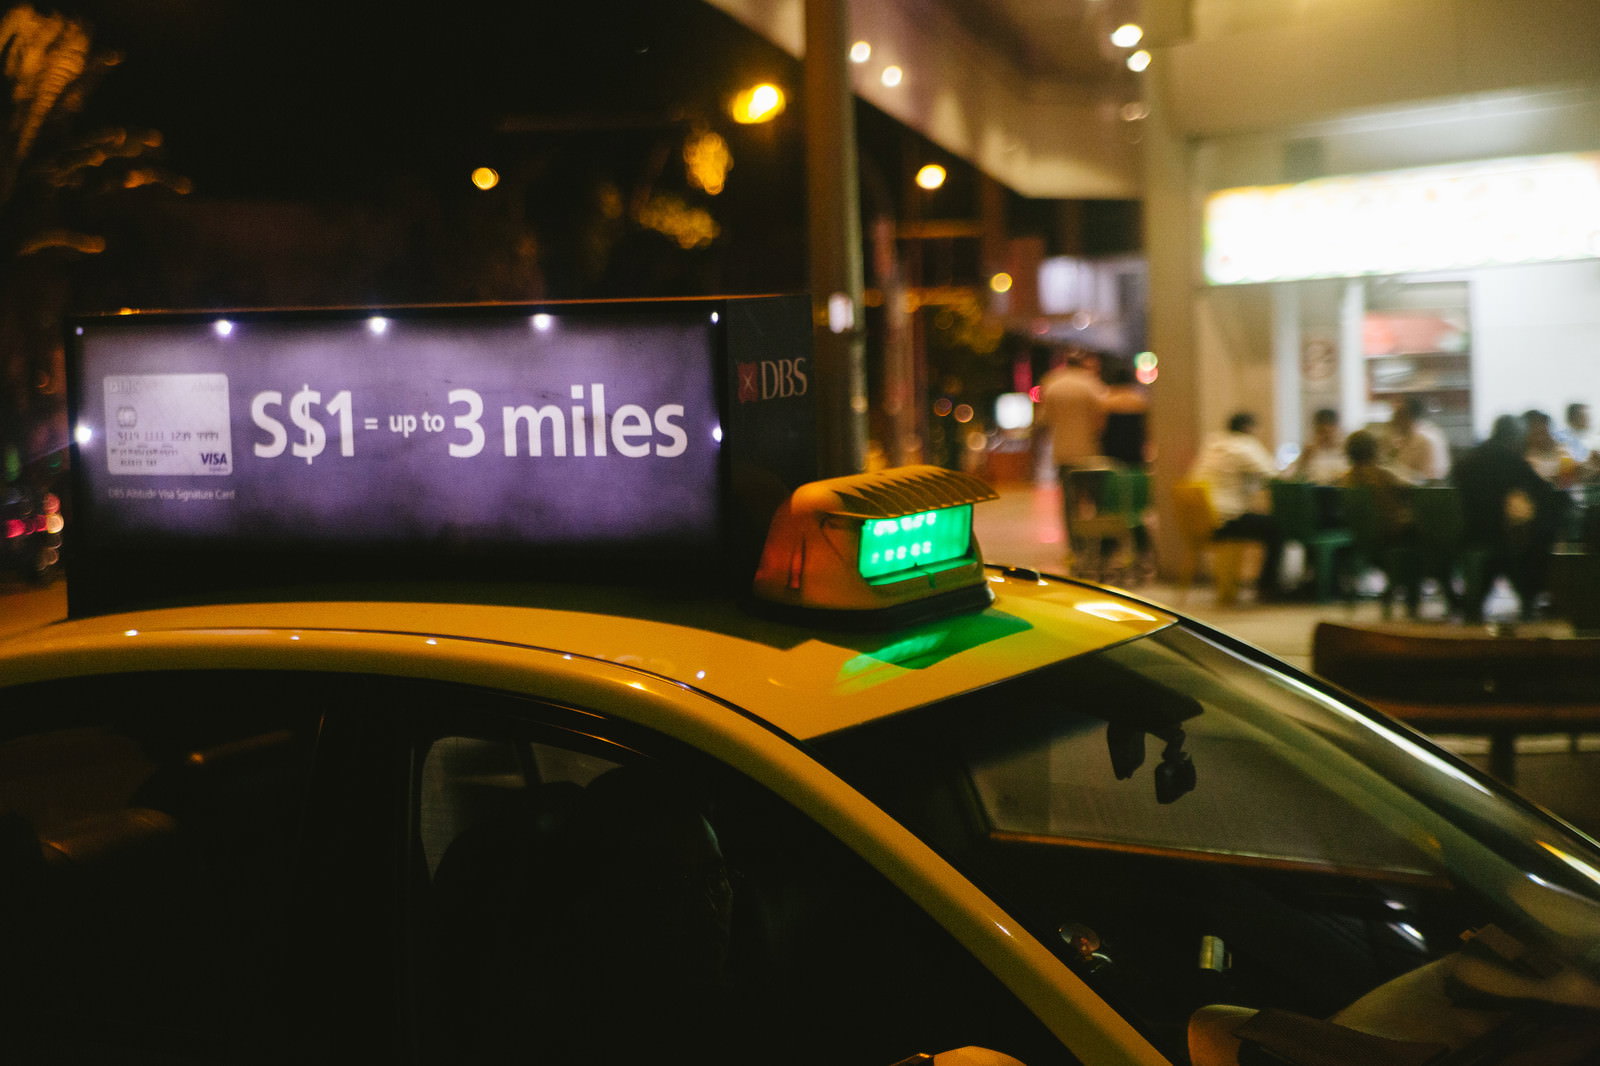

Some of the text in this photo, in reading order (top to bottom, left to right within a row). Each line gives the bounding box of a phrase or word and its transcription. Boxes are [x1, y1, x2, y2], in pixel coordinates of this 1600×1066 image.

[761, 357, 808, 400] DBS
[251, 383, 355, 465] S$1
[389, 414, 417, 438] up
[422, 412, 445, 433] to
[448, 389, 486, 458] 3
[502, 383, 688, 458] miles
[200, 452, 228, 465] VISA
[158, 489, 175, 500] Visa
[176, 488, 213, 502] Signature
[215, 489, 236, 500] Card
